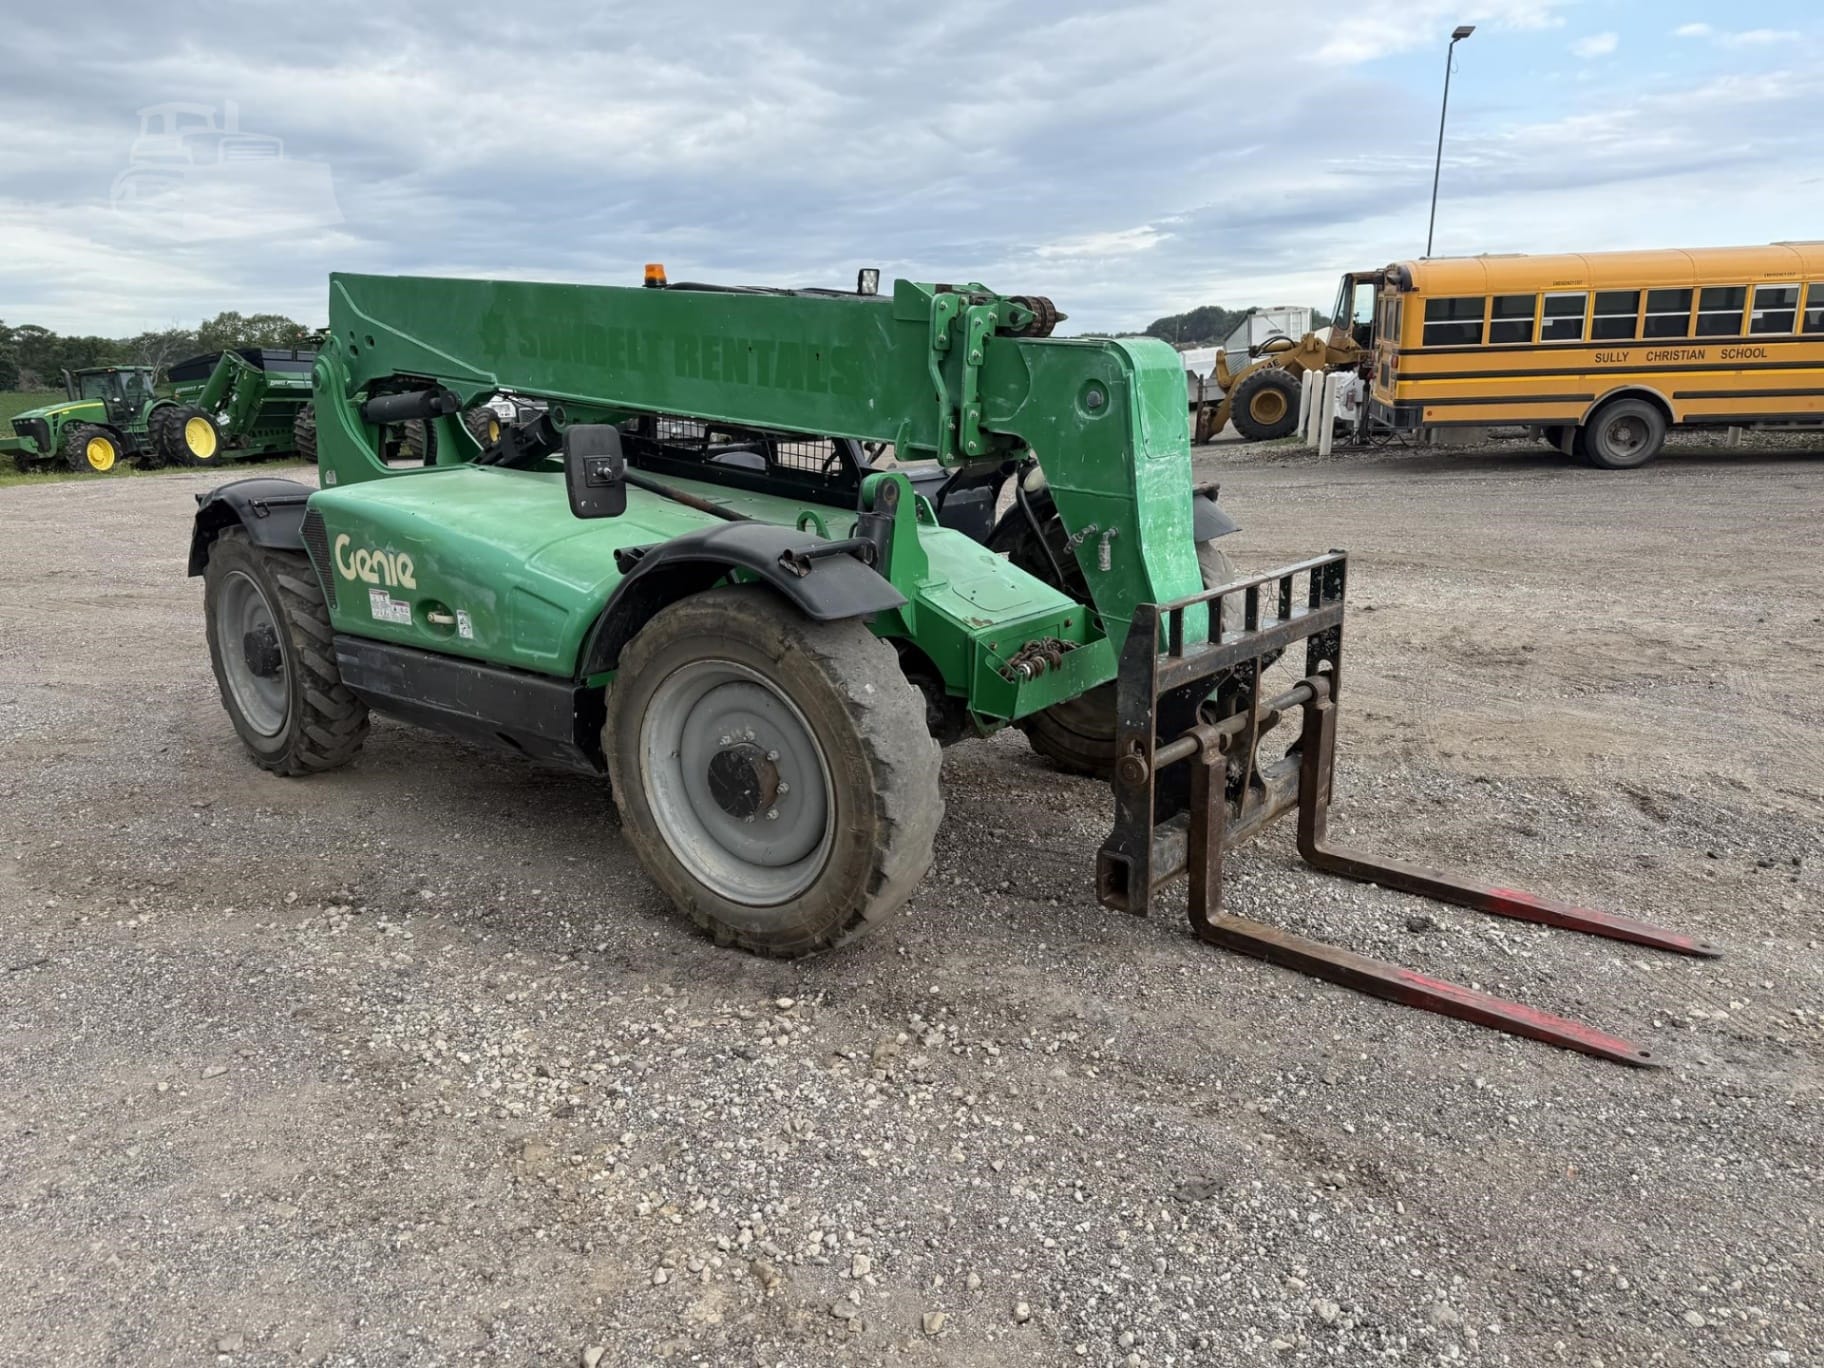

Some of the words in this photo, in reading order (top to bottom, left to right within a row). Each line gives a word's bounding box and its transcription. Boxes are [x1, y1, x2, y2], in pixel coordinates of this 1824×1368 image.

[674, 333, 864, 396] RENTALS
[1594, 351, 1630, 363] SULLY
[1645, 349, 1706, 362] CHRISTIAN
[1720, 347, 1768, 360] SCHOOL
[334, 532, 417, 590] Genie
